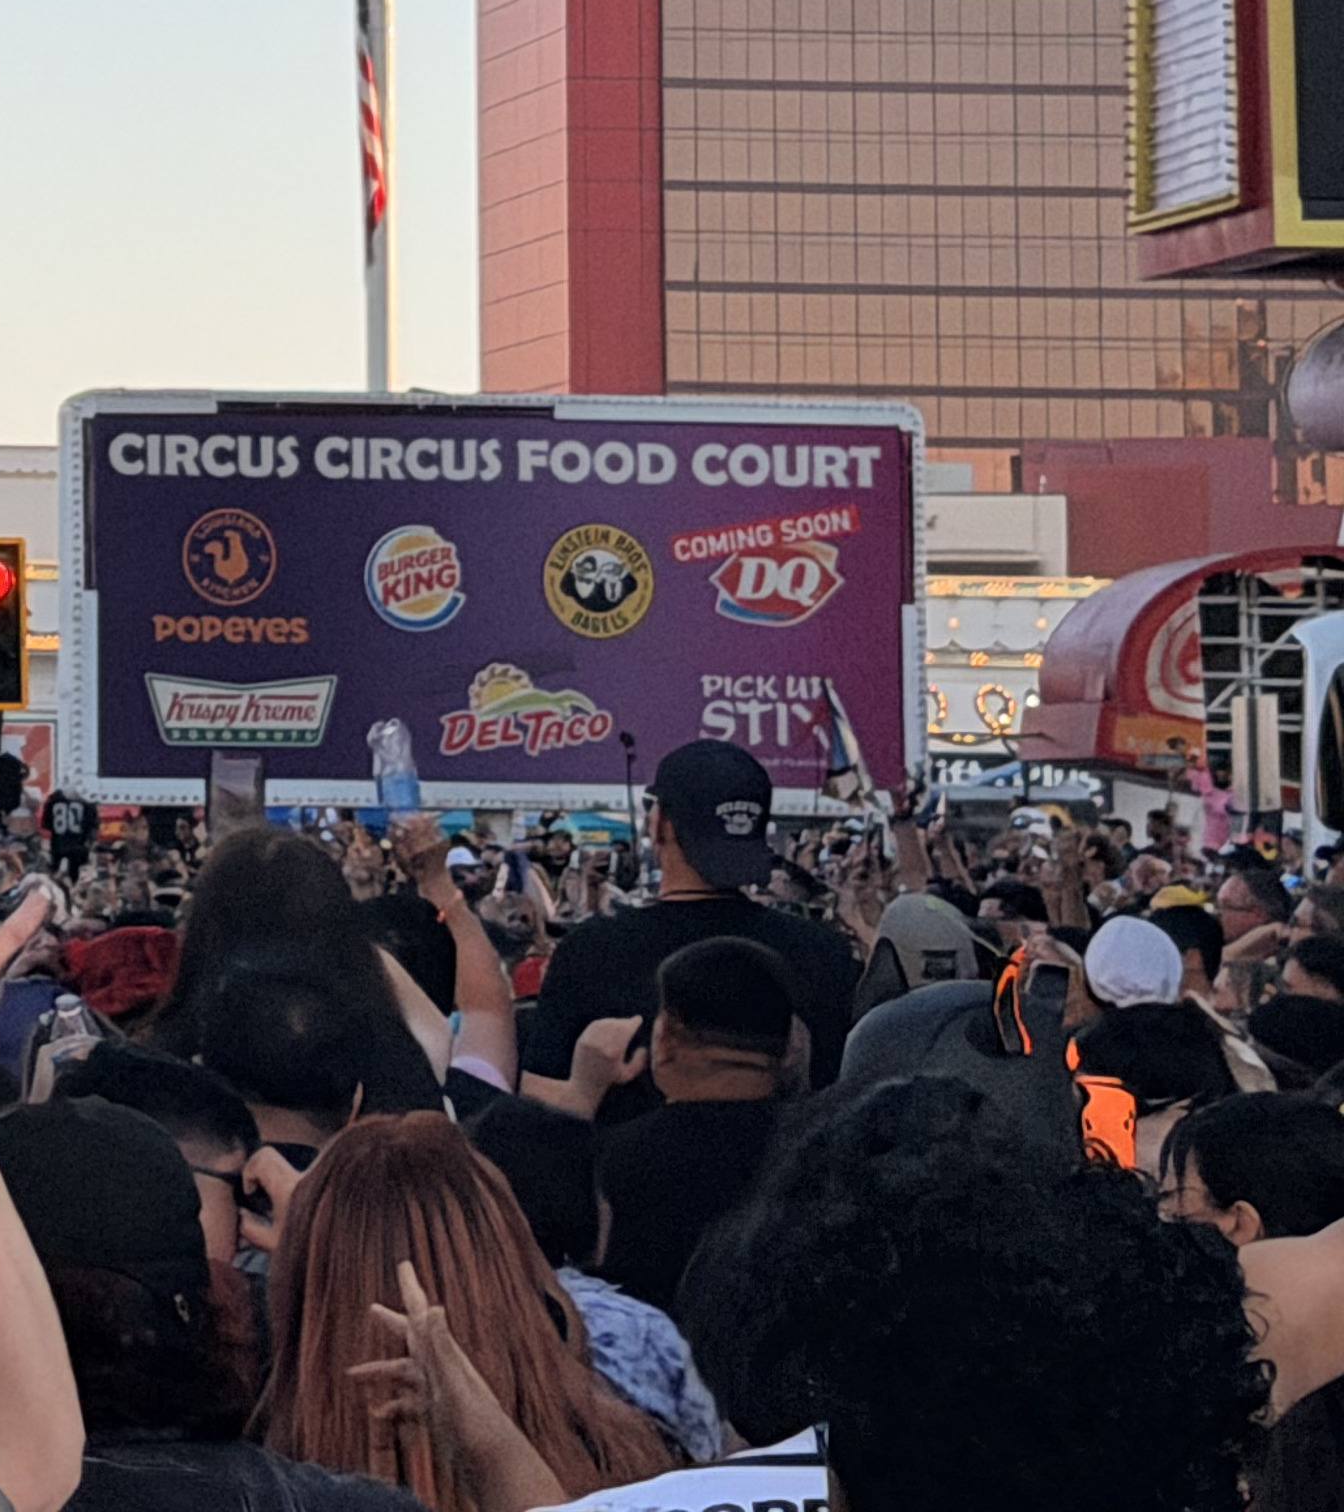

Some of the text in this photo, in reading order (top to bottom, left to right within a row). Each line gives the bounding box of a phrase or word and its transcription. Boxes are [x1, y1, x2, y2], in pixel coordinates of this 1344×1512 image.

[108, 432, 882, 488] CIRCUS CIRCUS FOOD COURT
[674, 509, 851, 562] COMING SOON
[377, 546, 453, 584] BURGER
[382, 563, 457, 607] KING
[735, 555, 822, 607] DQ
[570, 610, 630, 634] BAGELS
[699, 674, 779, 699] PICK
[166, 692, 320, 728] Krispy Kreme
[441, 709, 611, 754] DEL TACO
